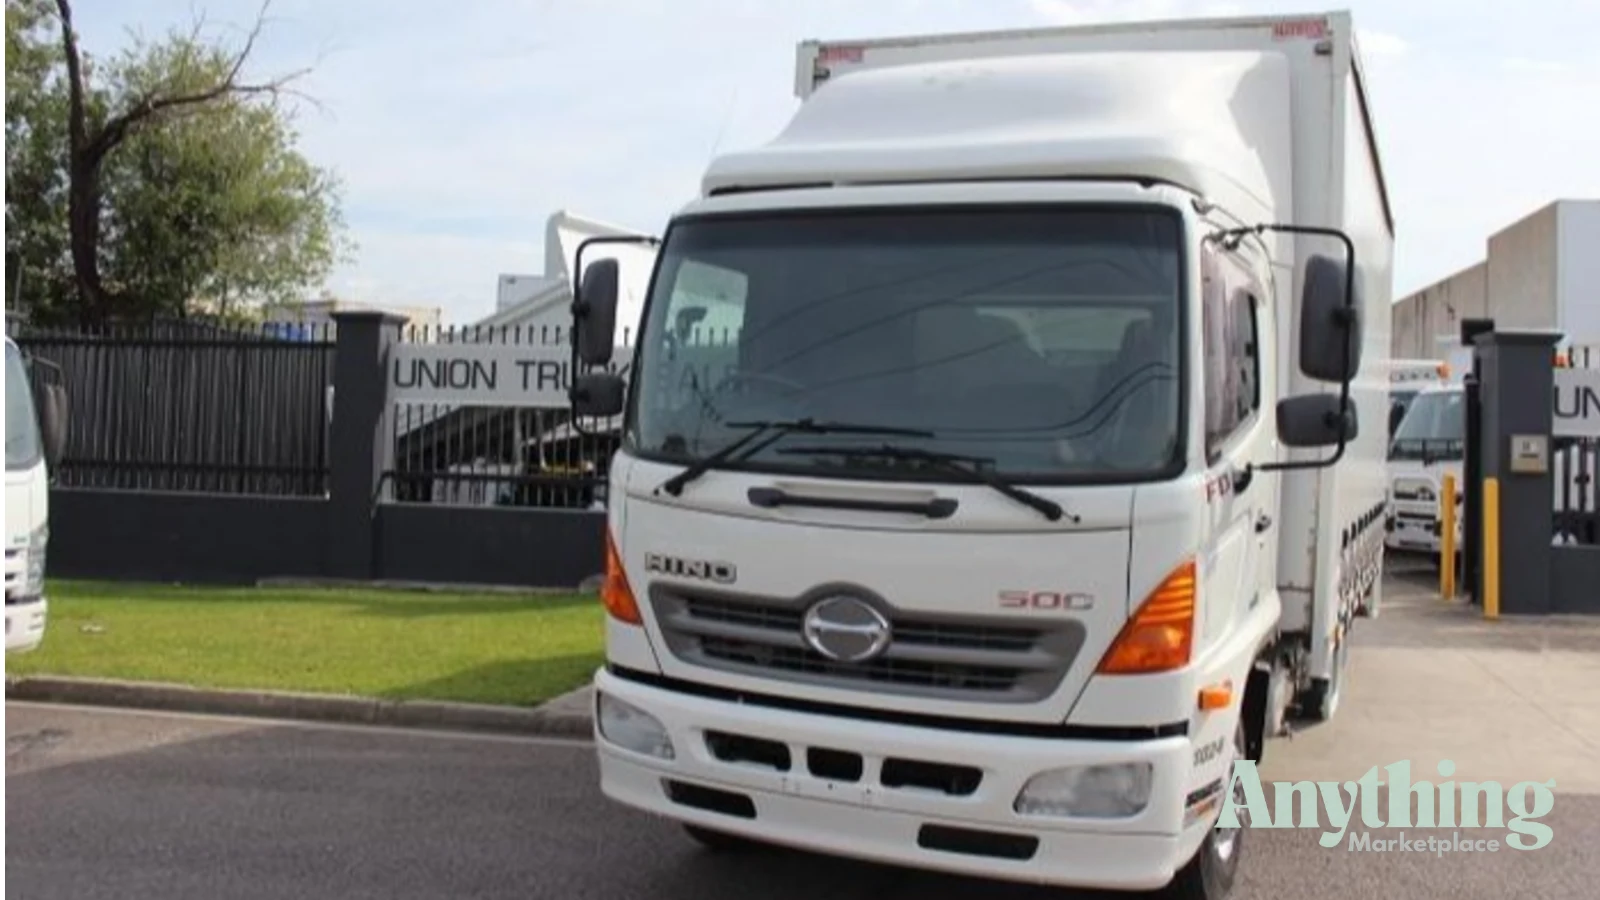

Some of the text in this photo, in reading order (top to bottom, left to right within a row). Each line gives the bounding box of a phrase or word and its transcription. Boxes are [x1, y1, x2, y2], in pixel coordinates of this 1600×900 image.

[393, 359, 497, 390] UNION
[1553, 385, 1600, 419] UN
[644, 552, 737, 585] HINO
[998, 590, 1094, 611] 500
